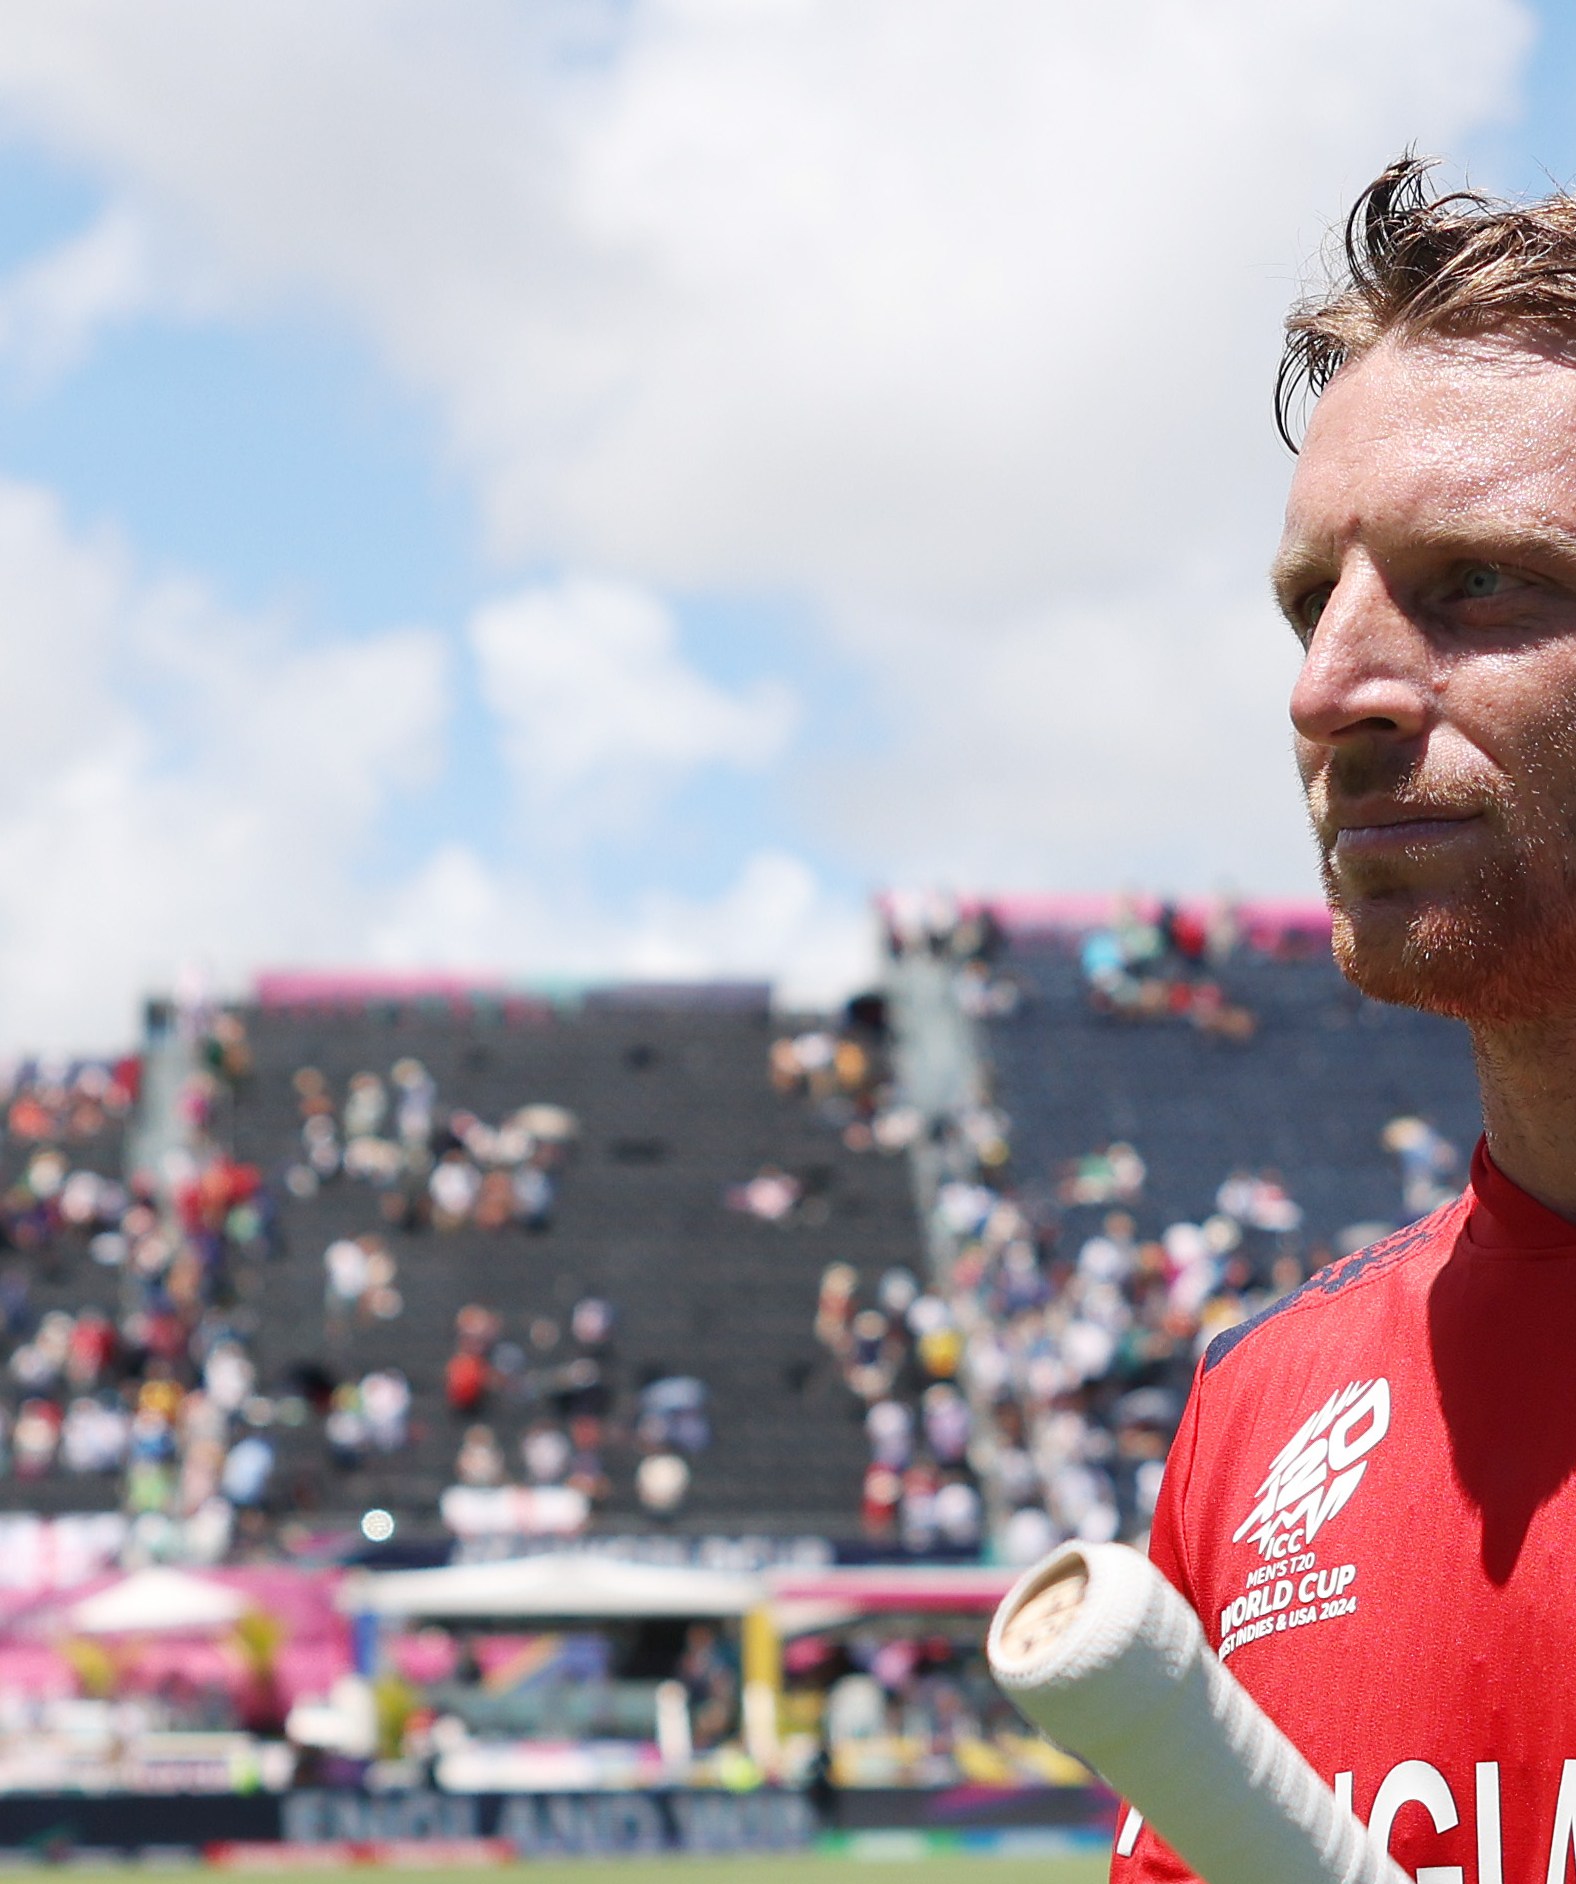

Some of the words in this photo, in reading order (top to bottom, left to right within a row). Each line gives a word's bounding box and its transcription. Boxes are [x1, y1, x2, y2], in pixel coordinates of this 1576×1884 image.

[1264, 1527, 1304, 1561] ICC
[1246, 1558, 1288, 1588] MEN'S
[1289, 1552, 1316, 1575] T20
[1220, 1579, 1293, 1638] WORLD
[1297, 1564, 1357, 1604] CUP
[1235, 1616, 1275, 1648] INDIES
[1275, 1613, 1288, 1632] &
[1288, 1605, 1318, 1629] USA
[1318, 1596, 1358, 1621] 2024
